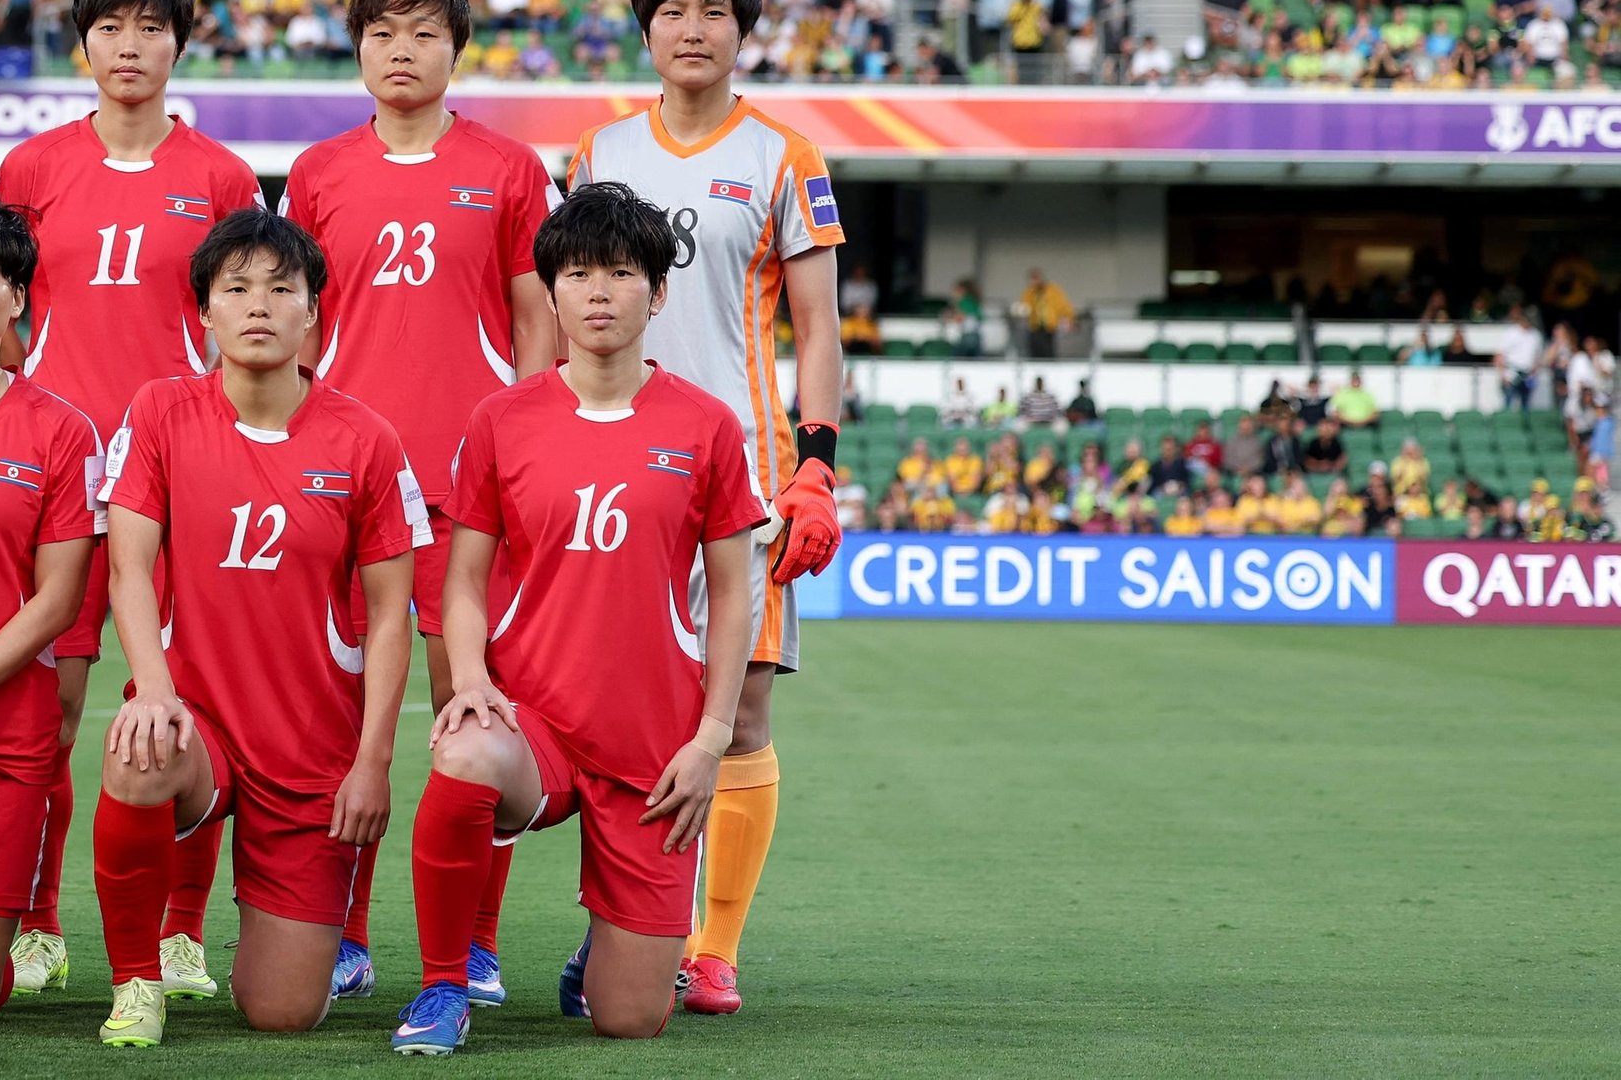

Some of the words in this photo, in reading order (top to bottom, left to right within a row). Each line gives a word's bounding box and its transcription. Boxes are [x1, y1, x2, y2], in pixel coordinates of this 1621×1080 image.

[88, 223, 145, 286] 11
[372, 221, 436, 286] 23
[663, 207, 699, 269] 8
[218, 501, 287, 571] 12
[564, 482, 628, 552] 16
[849, 543, 1100, 606] CREDIT
[1119, 547, 1382, 610] SAISON
[1422, 551, 1621, 618] QATAR
